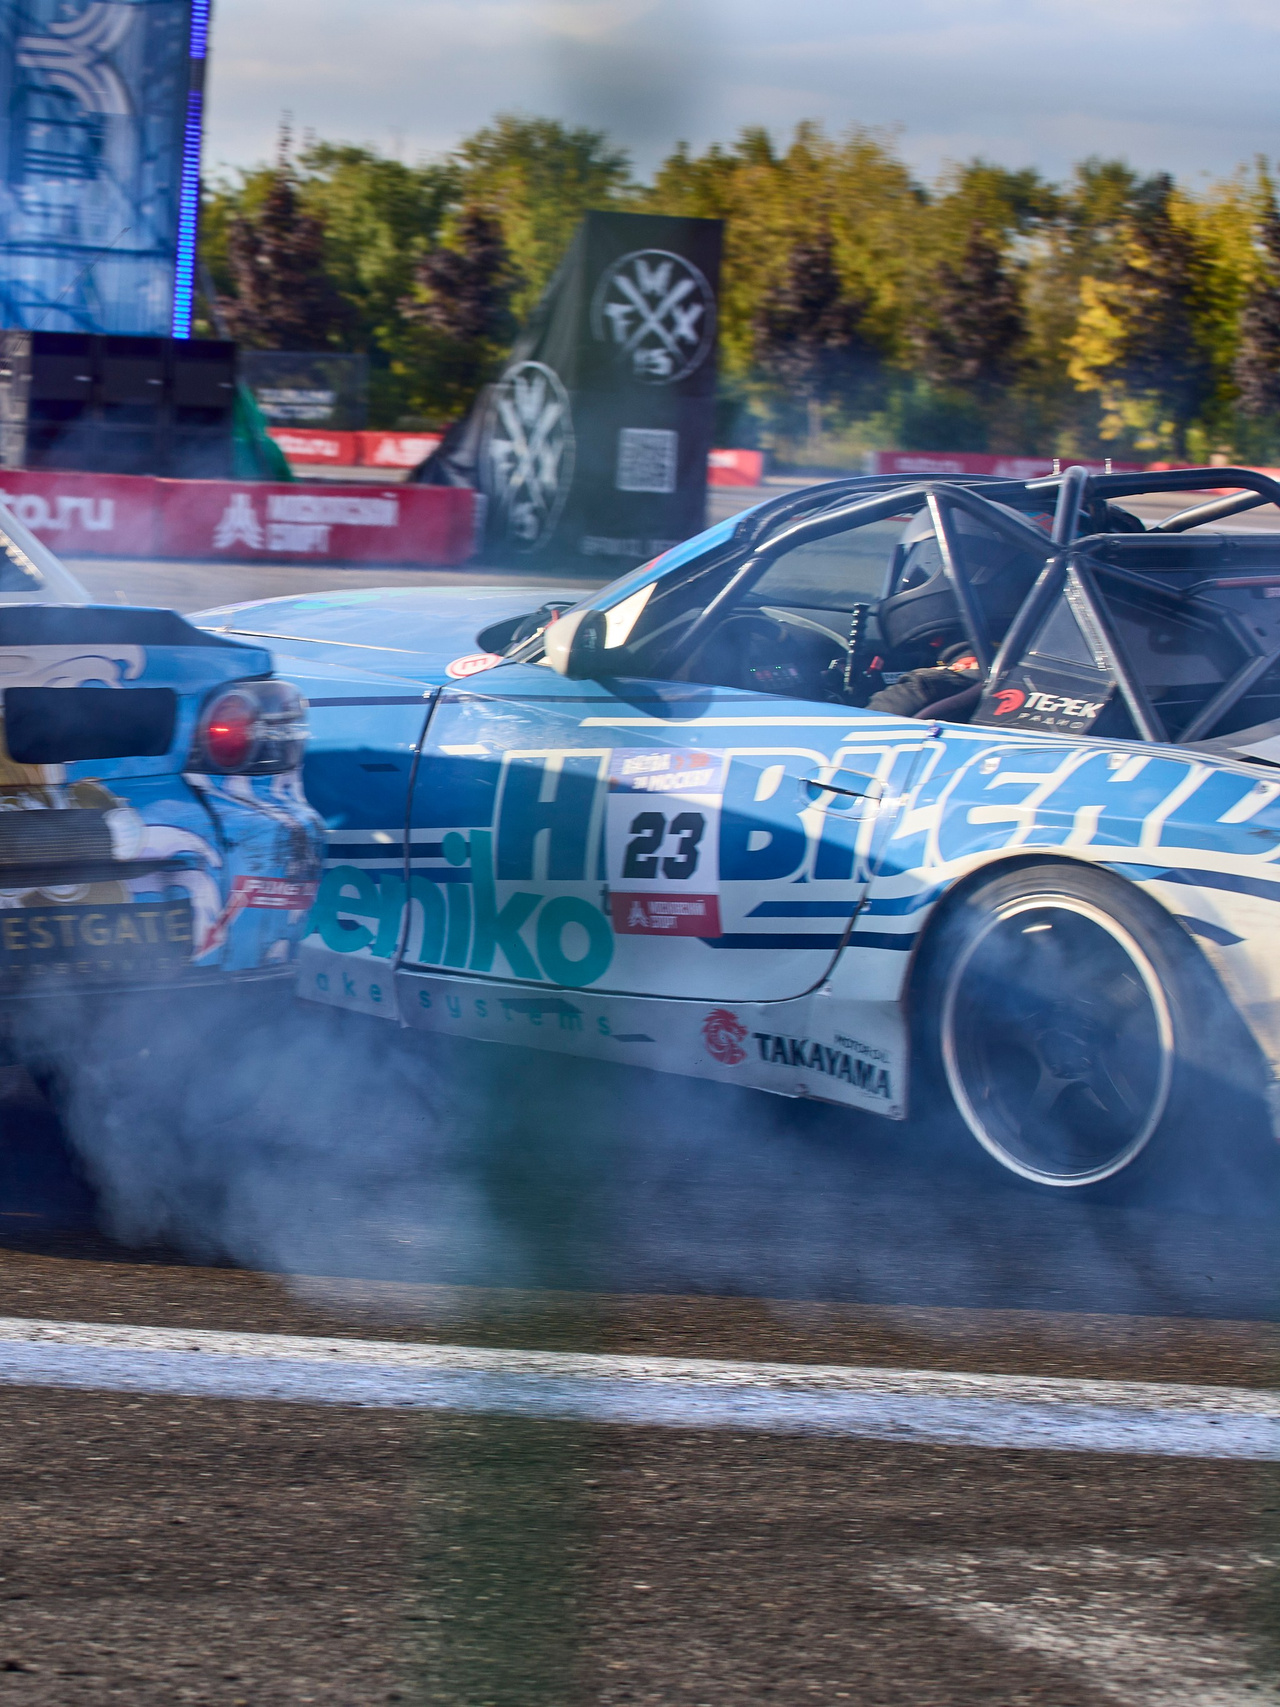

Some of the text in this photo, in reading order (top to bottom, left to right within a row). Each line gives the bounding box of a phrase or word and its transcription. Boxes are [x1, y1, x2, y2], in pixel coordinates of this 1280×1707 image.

[621, 810, 706, 880] 23
[419, 989, 612, 1037] systems
[752, 1031, 893, 1100] TAKAYAMA
